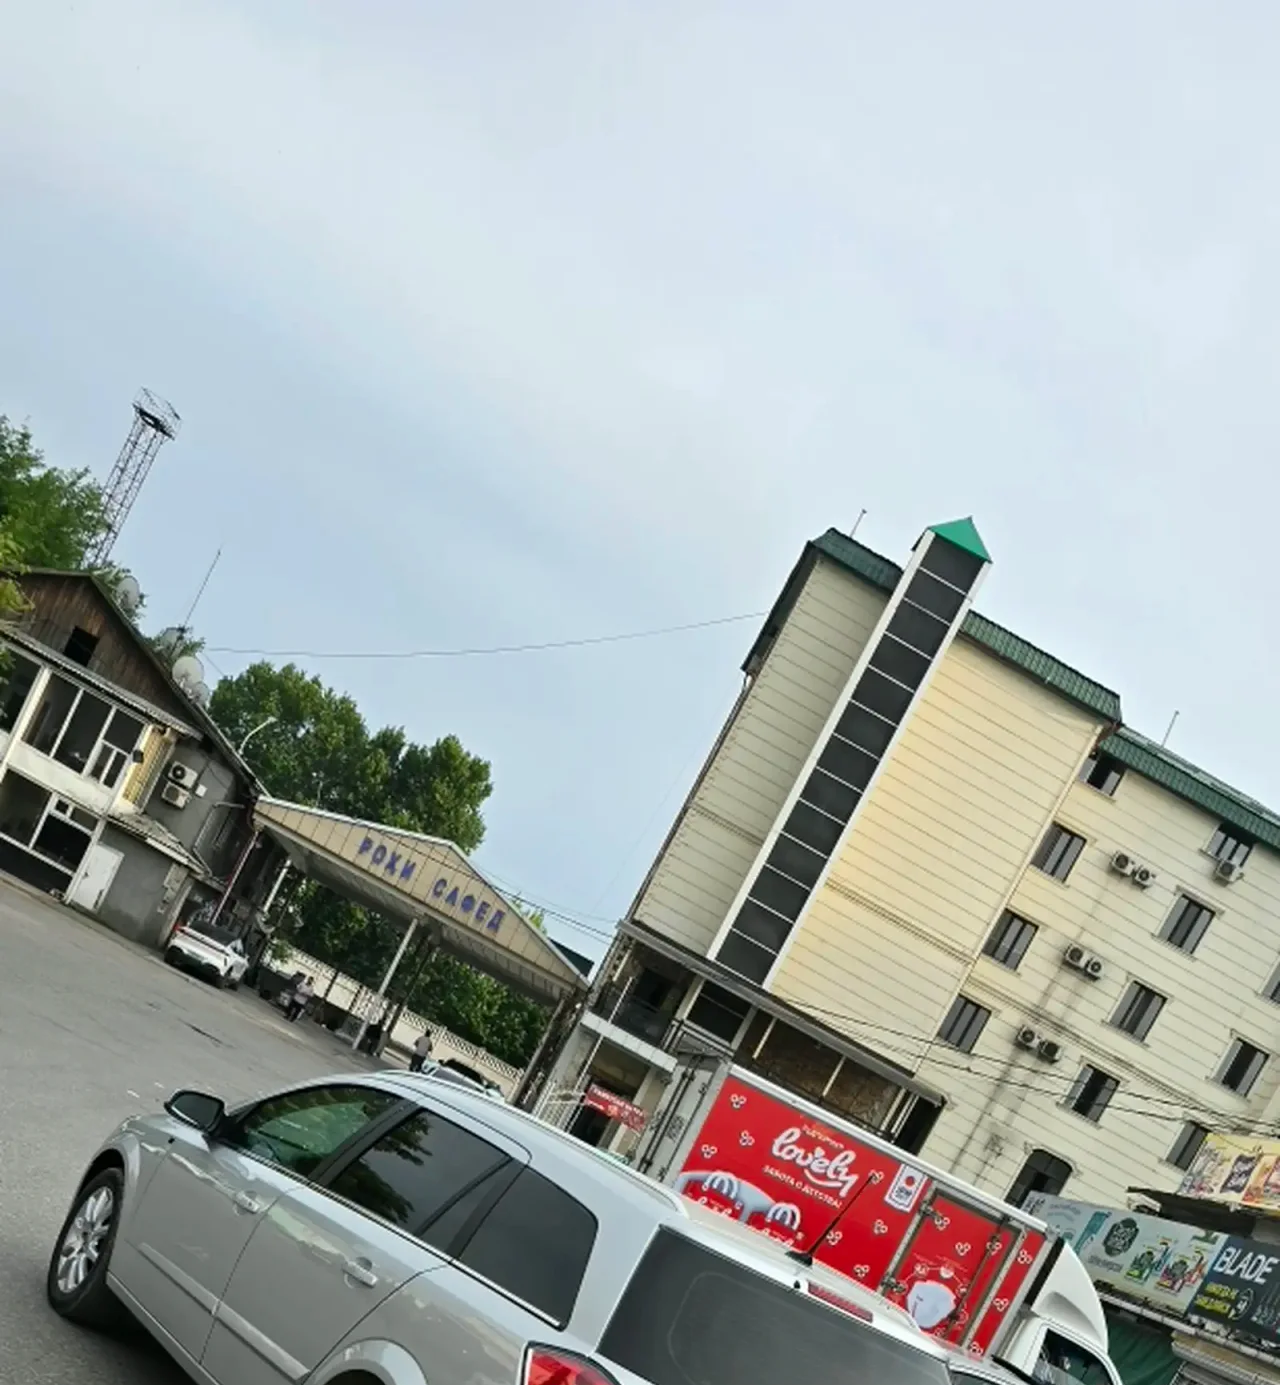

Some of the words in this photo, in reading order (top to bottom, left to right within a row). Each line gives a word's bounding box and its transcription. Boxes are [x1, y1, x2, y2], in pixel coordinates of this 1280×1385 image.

[432, 878, 506, 933] САФЕД
[771, 1126, 859, 1198] lovely
[1212, 1245, 1280, 1285] BLADE
